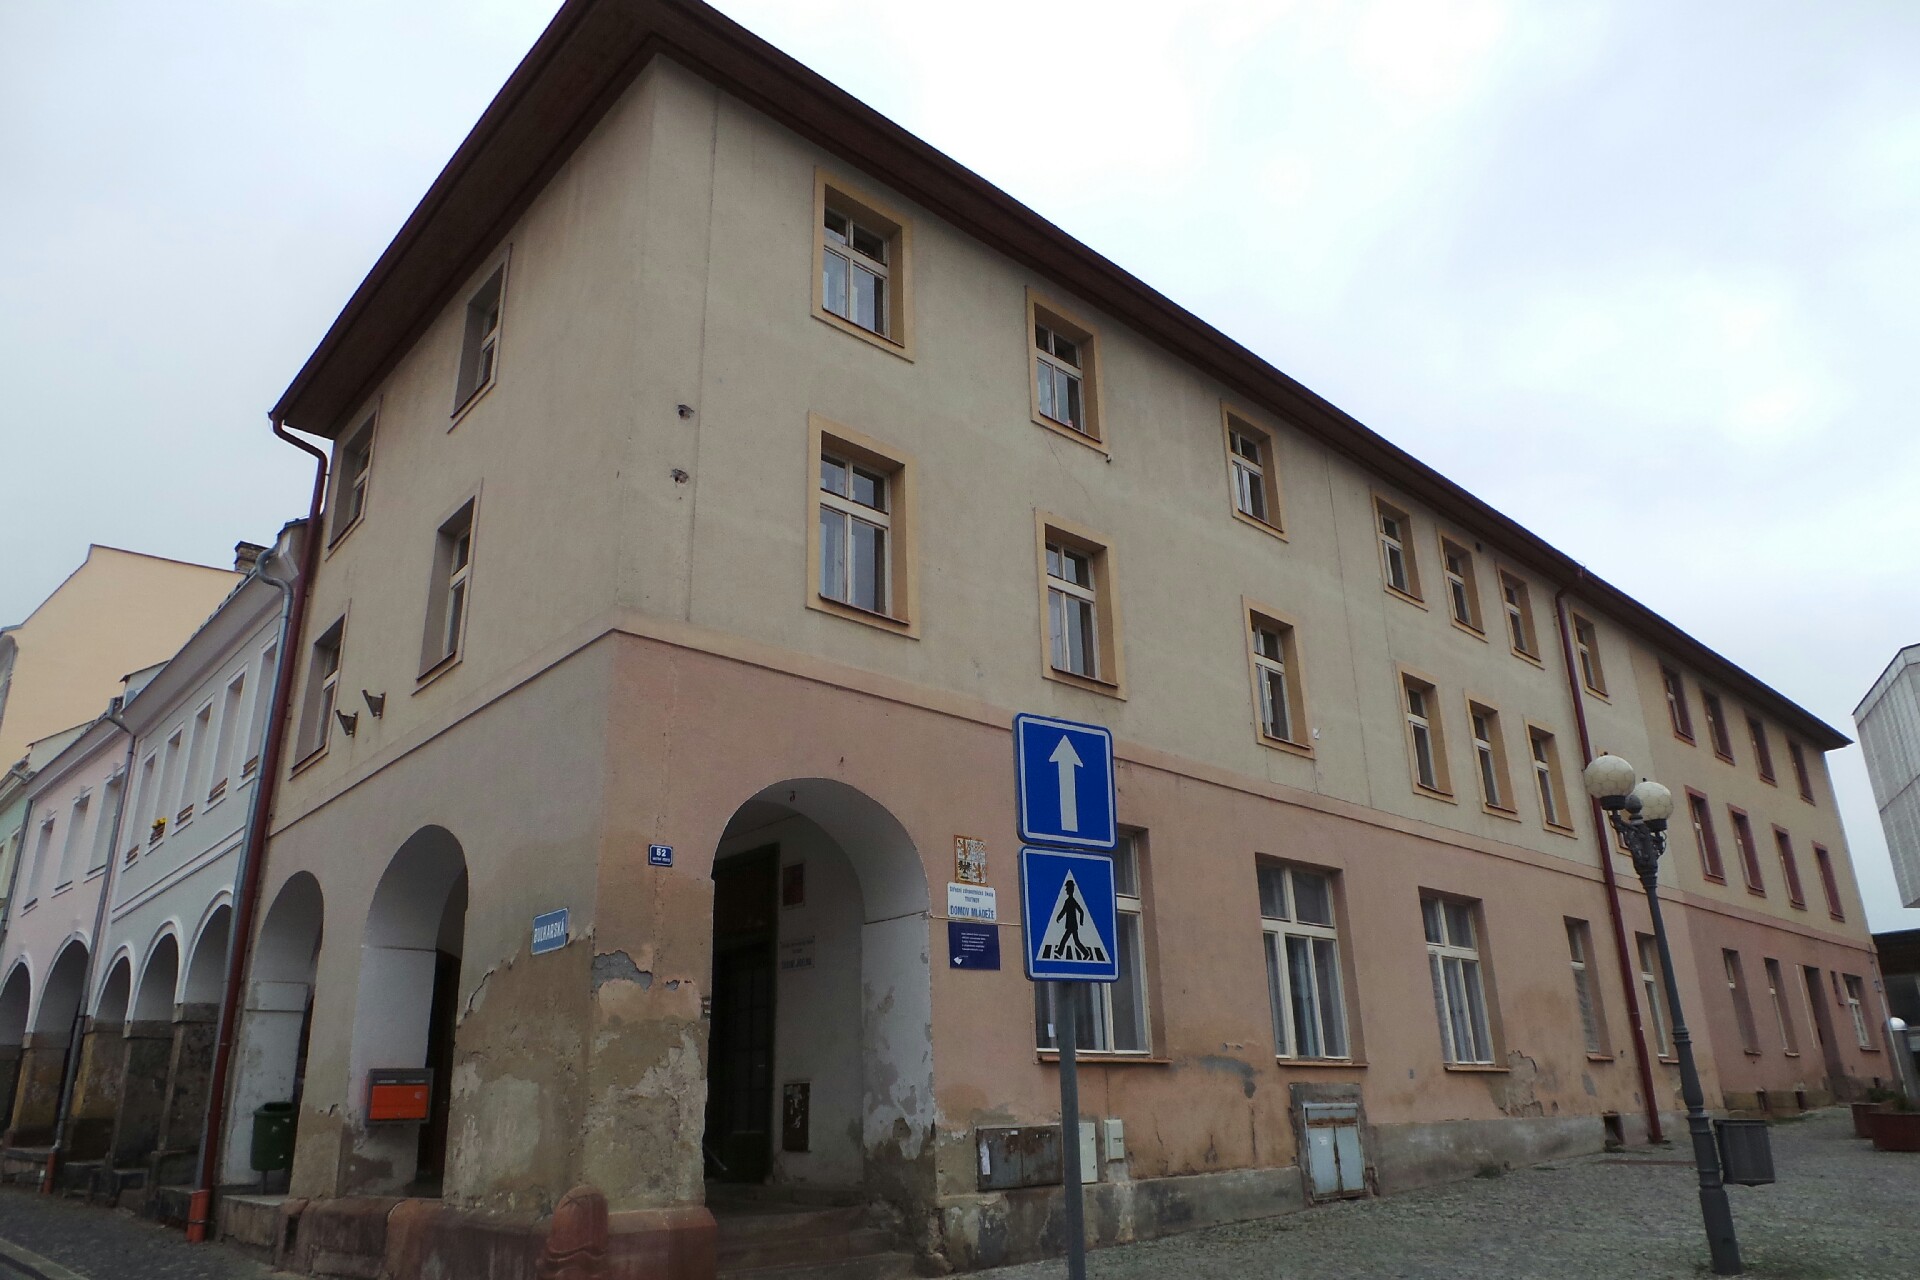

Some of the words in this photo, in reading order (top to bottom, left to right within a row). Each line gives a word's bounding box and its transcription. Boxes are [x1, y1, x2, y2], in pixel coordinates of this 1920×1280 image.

[656, 847, 667, 857] 52
[950, 905, 970, 916] DOMOV
[971, 907, 994, 919] MLÁDEŽE
